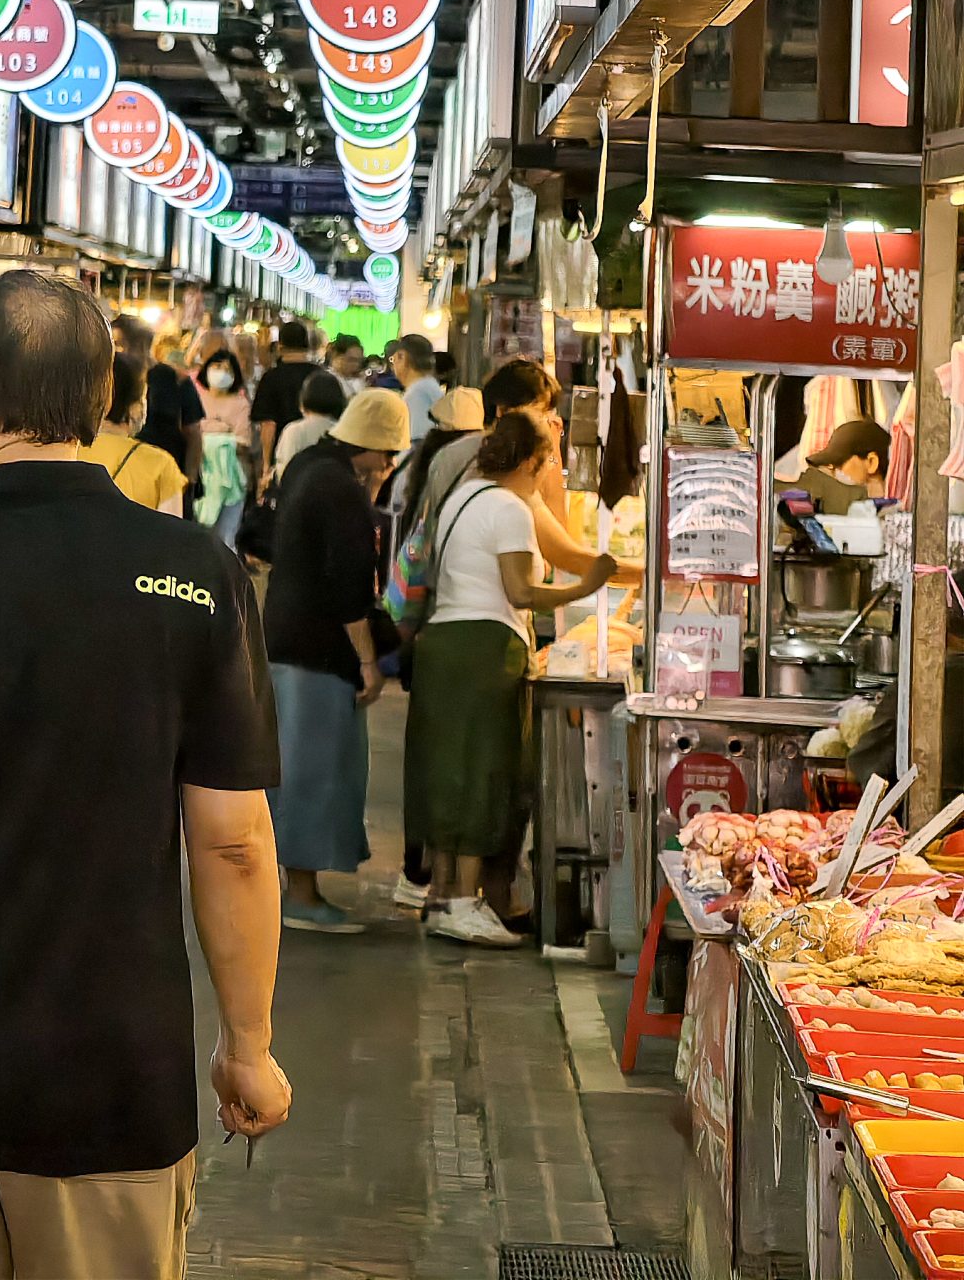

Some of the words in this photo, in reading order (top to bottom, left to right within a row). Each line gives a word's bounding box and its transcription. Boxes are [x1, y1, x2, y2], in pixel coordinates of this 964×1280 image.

[343, 5, 397, 28] 148
[347, 53, 393, 74] 149
[45, 89, 83, 106] 104
[686, 254, 814, 323] 米粉羹
[836, 263, 919, 330] 鹹粥
